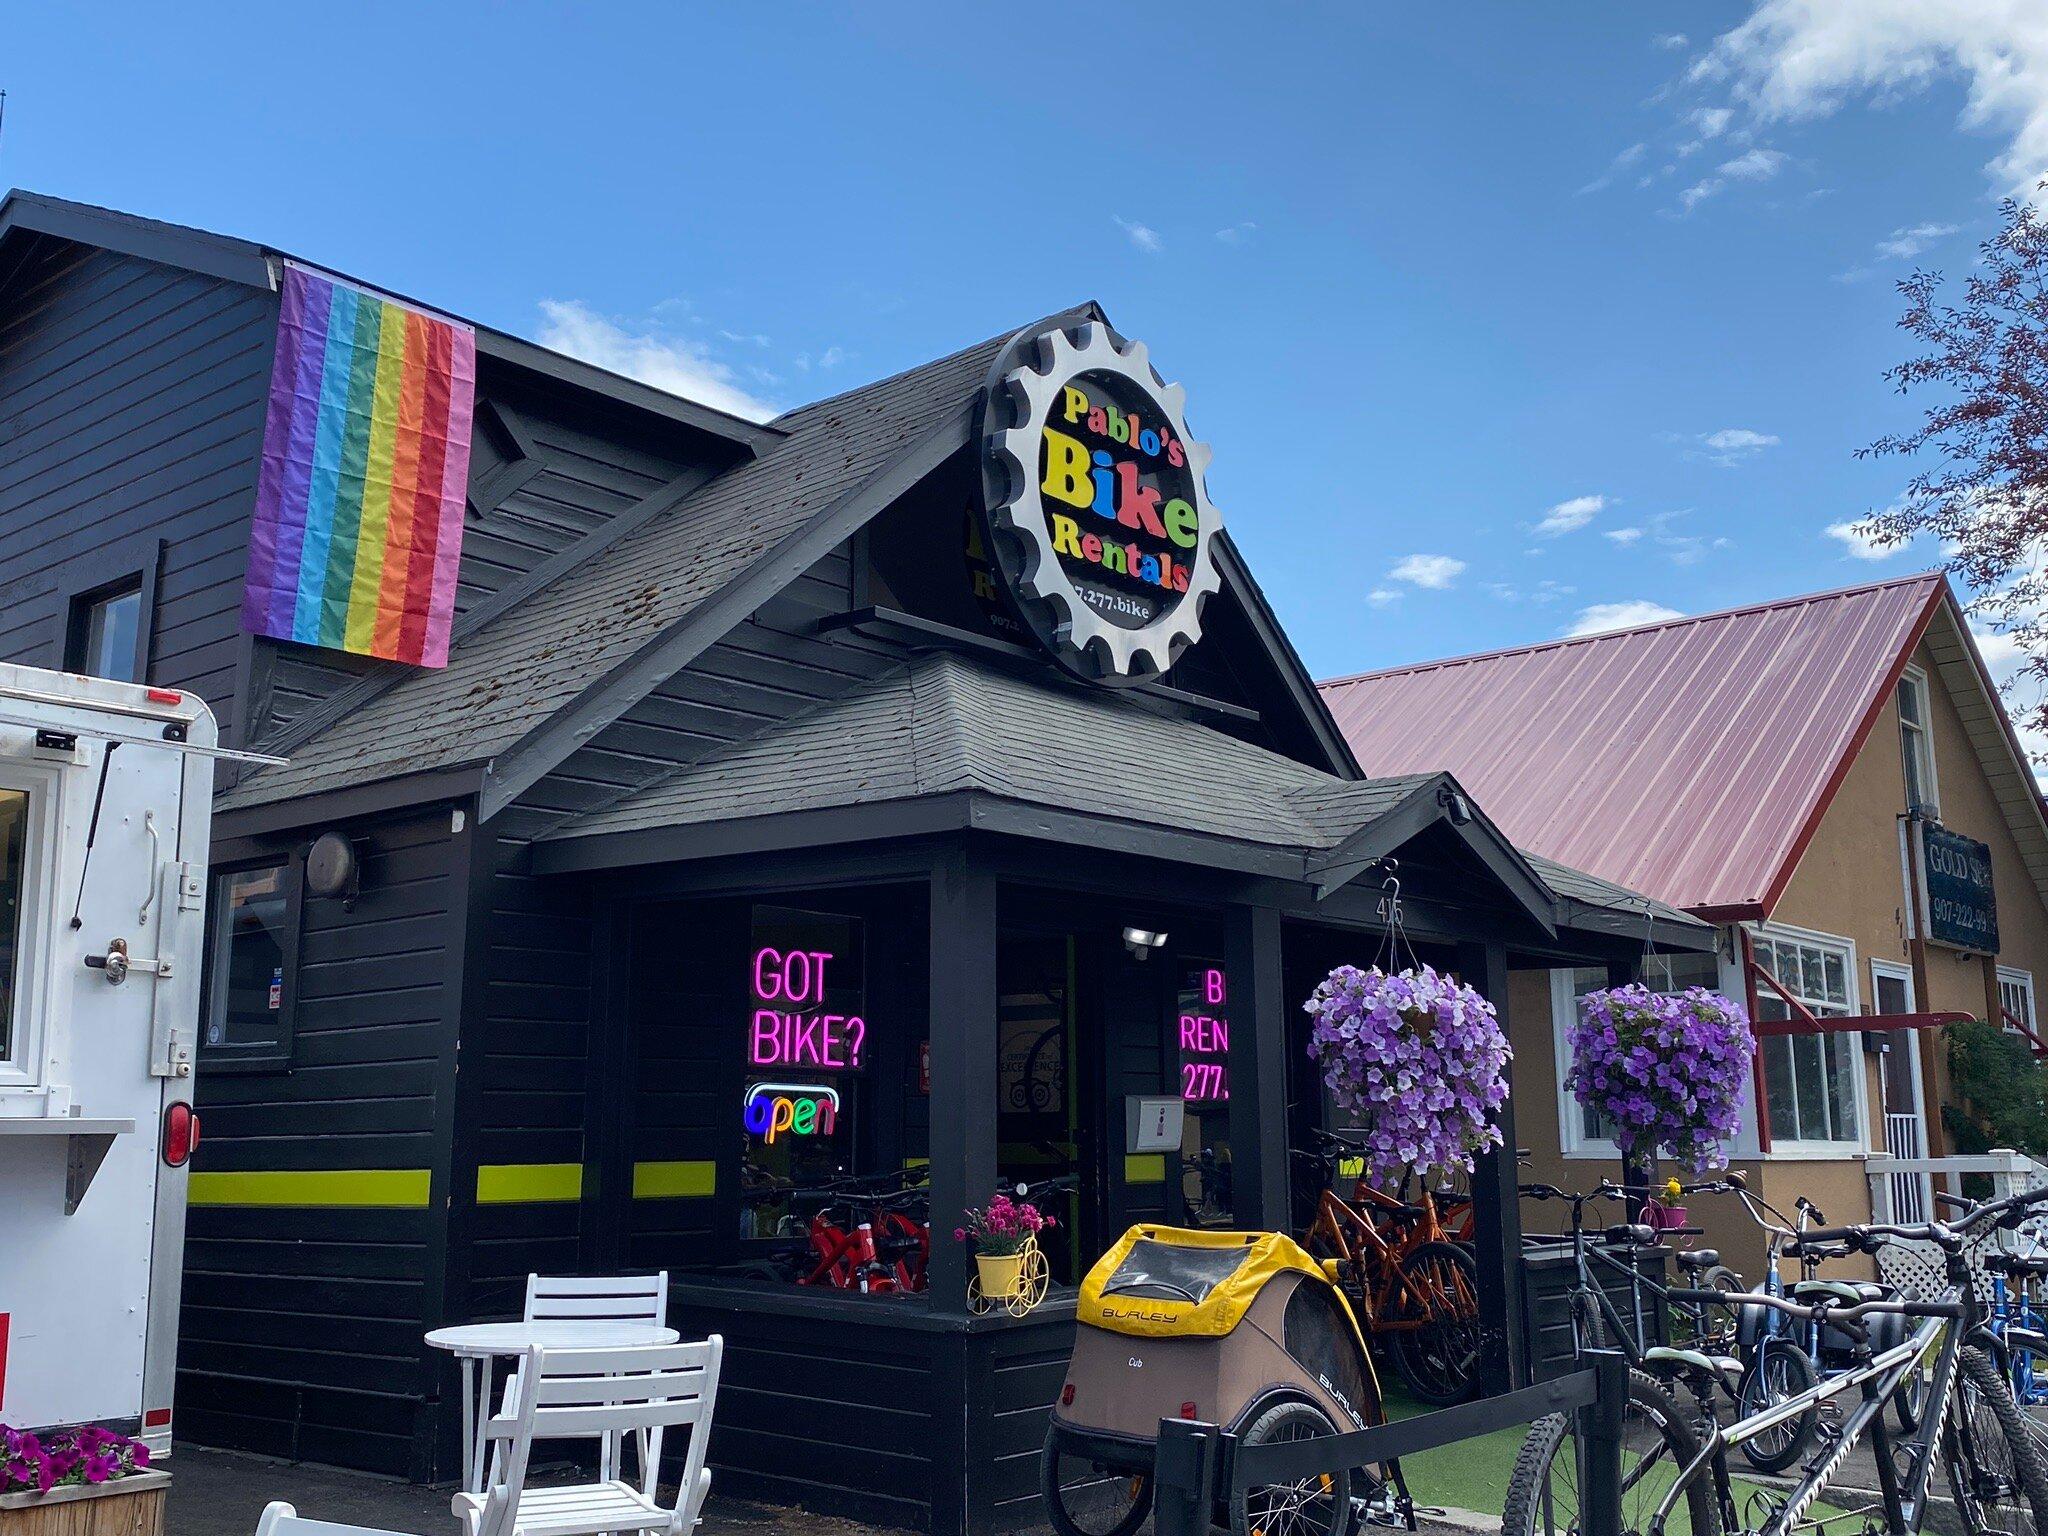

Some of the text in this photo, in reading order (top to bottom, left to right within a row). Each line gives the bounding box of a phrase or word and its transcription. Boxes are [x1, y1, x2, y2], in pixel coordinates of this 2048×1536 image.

[1064, 385, 1184, 467] Pablo's
[1041, 426, 1199, 548] Bike
[1052, 512, 1190, 593] Rentals
[1930, 845, 1968, 879] GOLD
[1934, 897, 1996, 935] 907-222-99
[753, 946, 834, 1002] GOT
[1207, 969, 1222, 1003] B
[753, 1009, 866, 1067] BIKE?
[1180, 1015, 1228, 1051] REN
[745, 1095, 837, 1145] open
[1102, 1308, 1177, 1323] BURLEY
[1128, 1357, 1143, 1368] Cub
[1319, 1373, 1368, 1430] BURLEY
